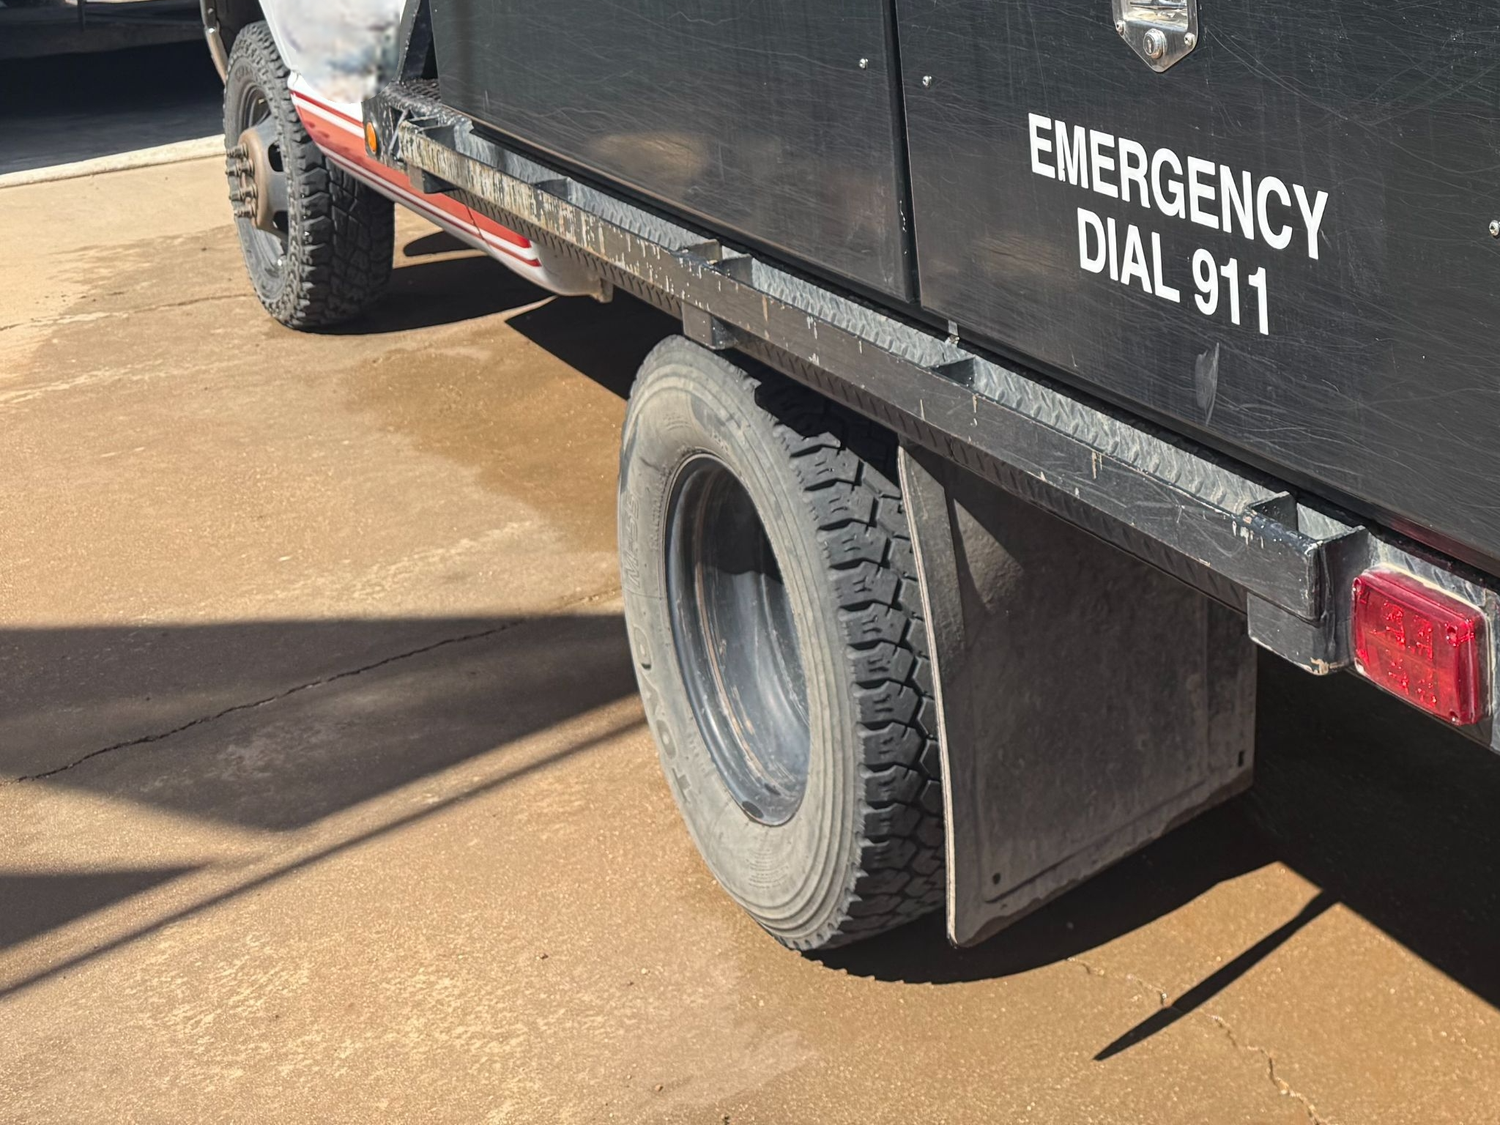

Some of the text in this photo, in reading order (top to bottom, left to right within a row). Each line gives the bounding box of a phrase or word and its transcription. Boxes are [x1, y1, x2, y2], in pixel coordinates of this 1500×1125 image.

[1028, 112, 1329, 261] EMERGENCY
[1076, 207, 1269, 336] DIAL 911
[633, 624, 691, 804] TOYO
